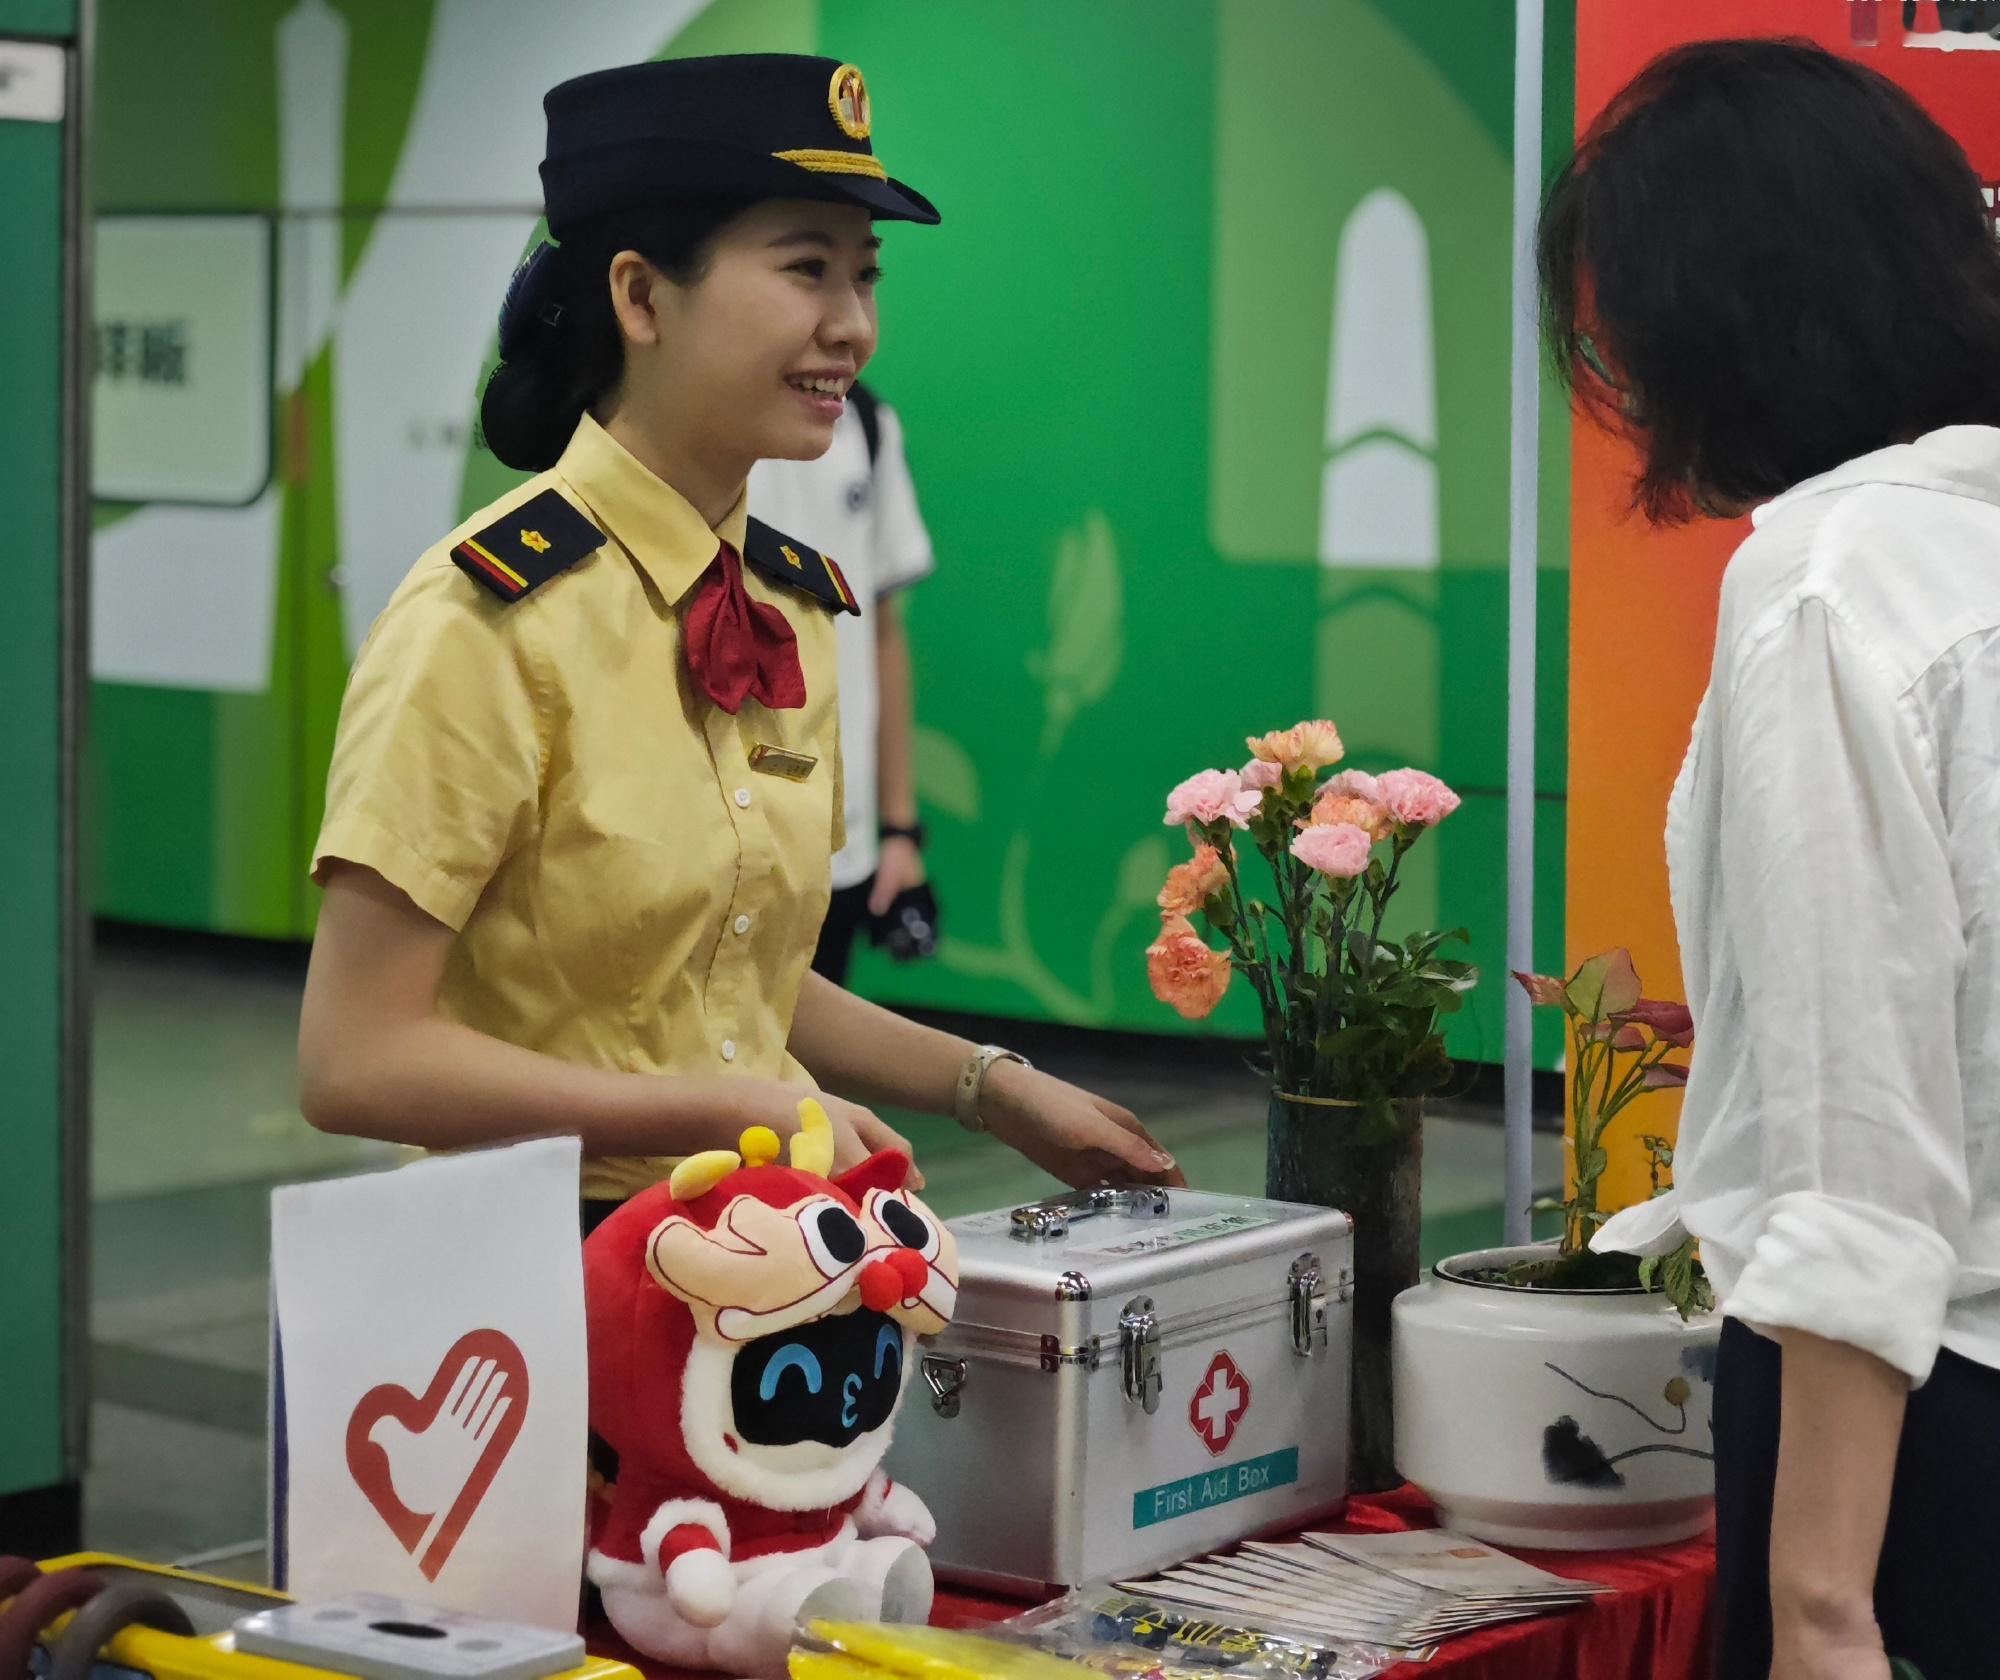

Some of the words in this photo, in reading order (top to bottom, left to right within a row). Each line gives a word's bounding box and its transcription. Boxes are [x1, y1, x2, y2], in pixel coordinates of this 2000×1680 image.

[1154, 1482, 1193, 1517] First
[1201, 1472, 1229, 1501] Aid
[1238, 1464, 1270, 1492] Box
